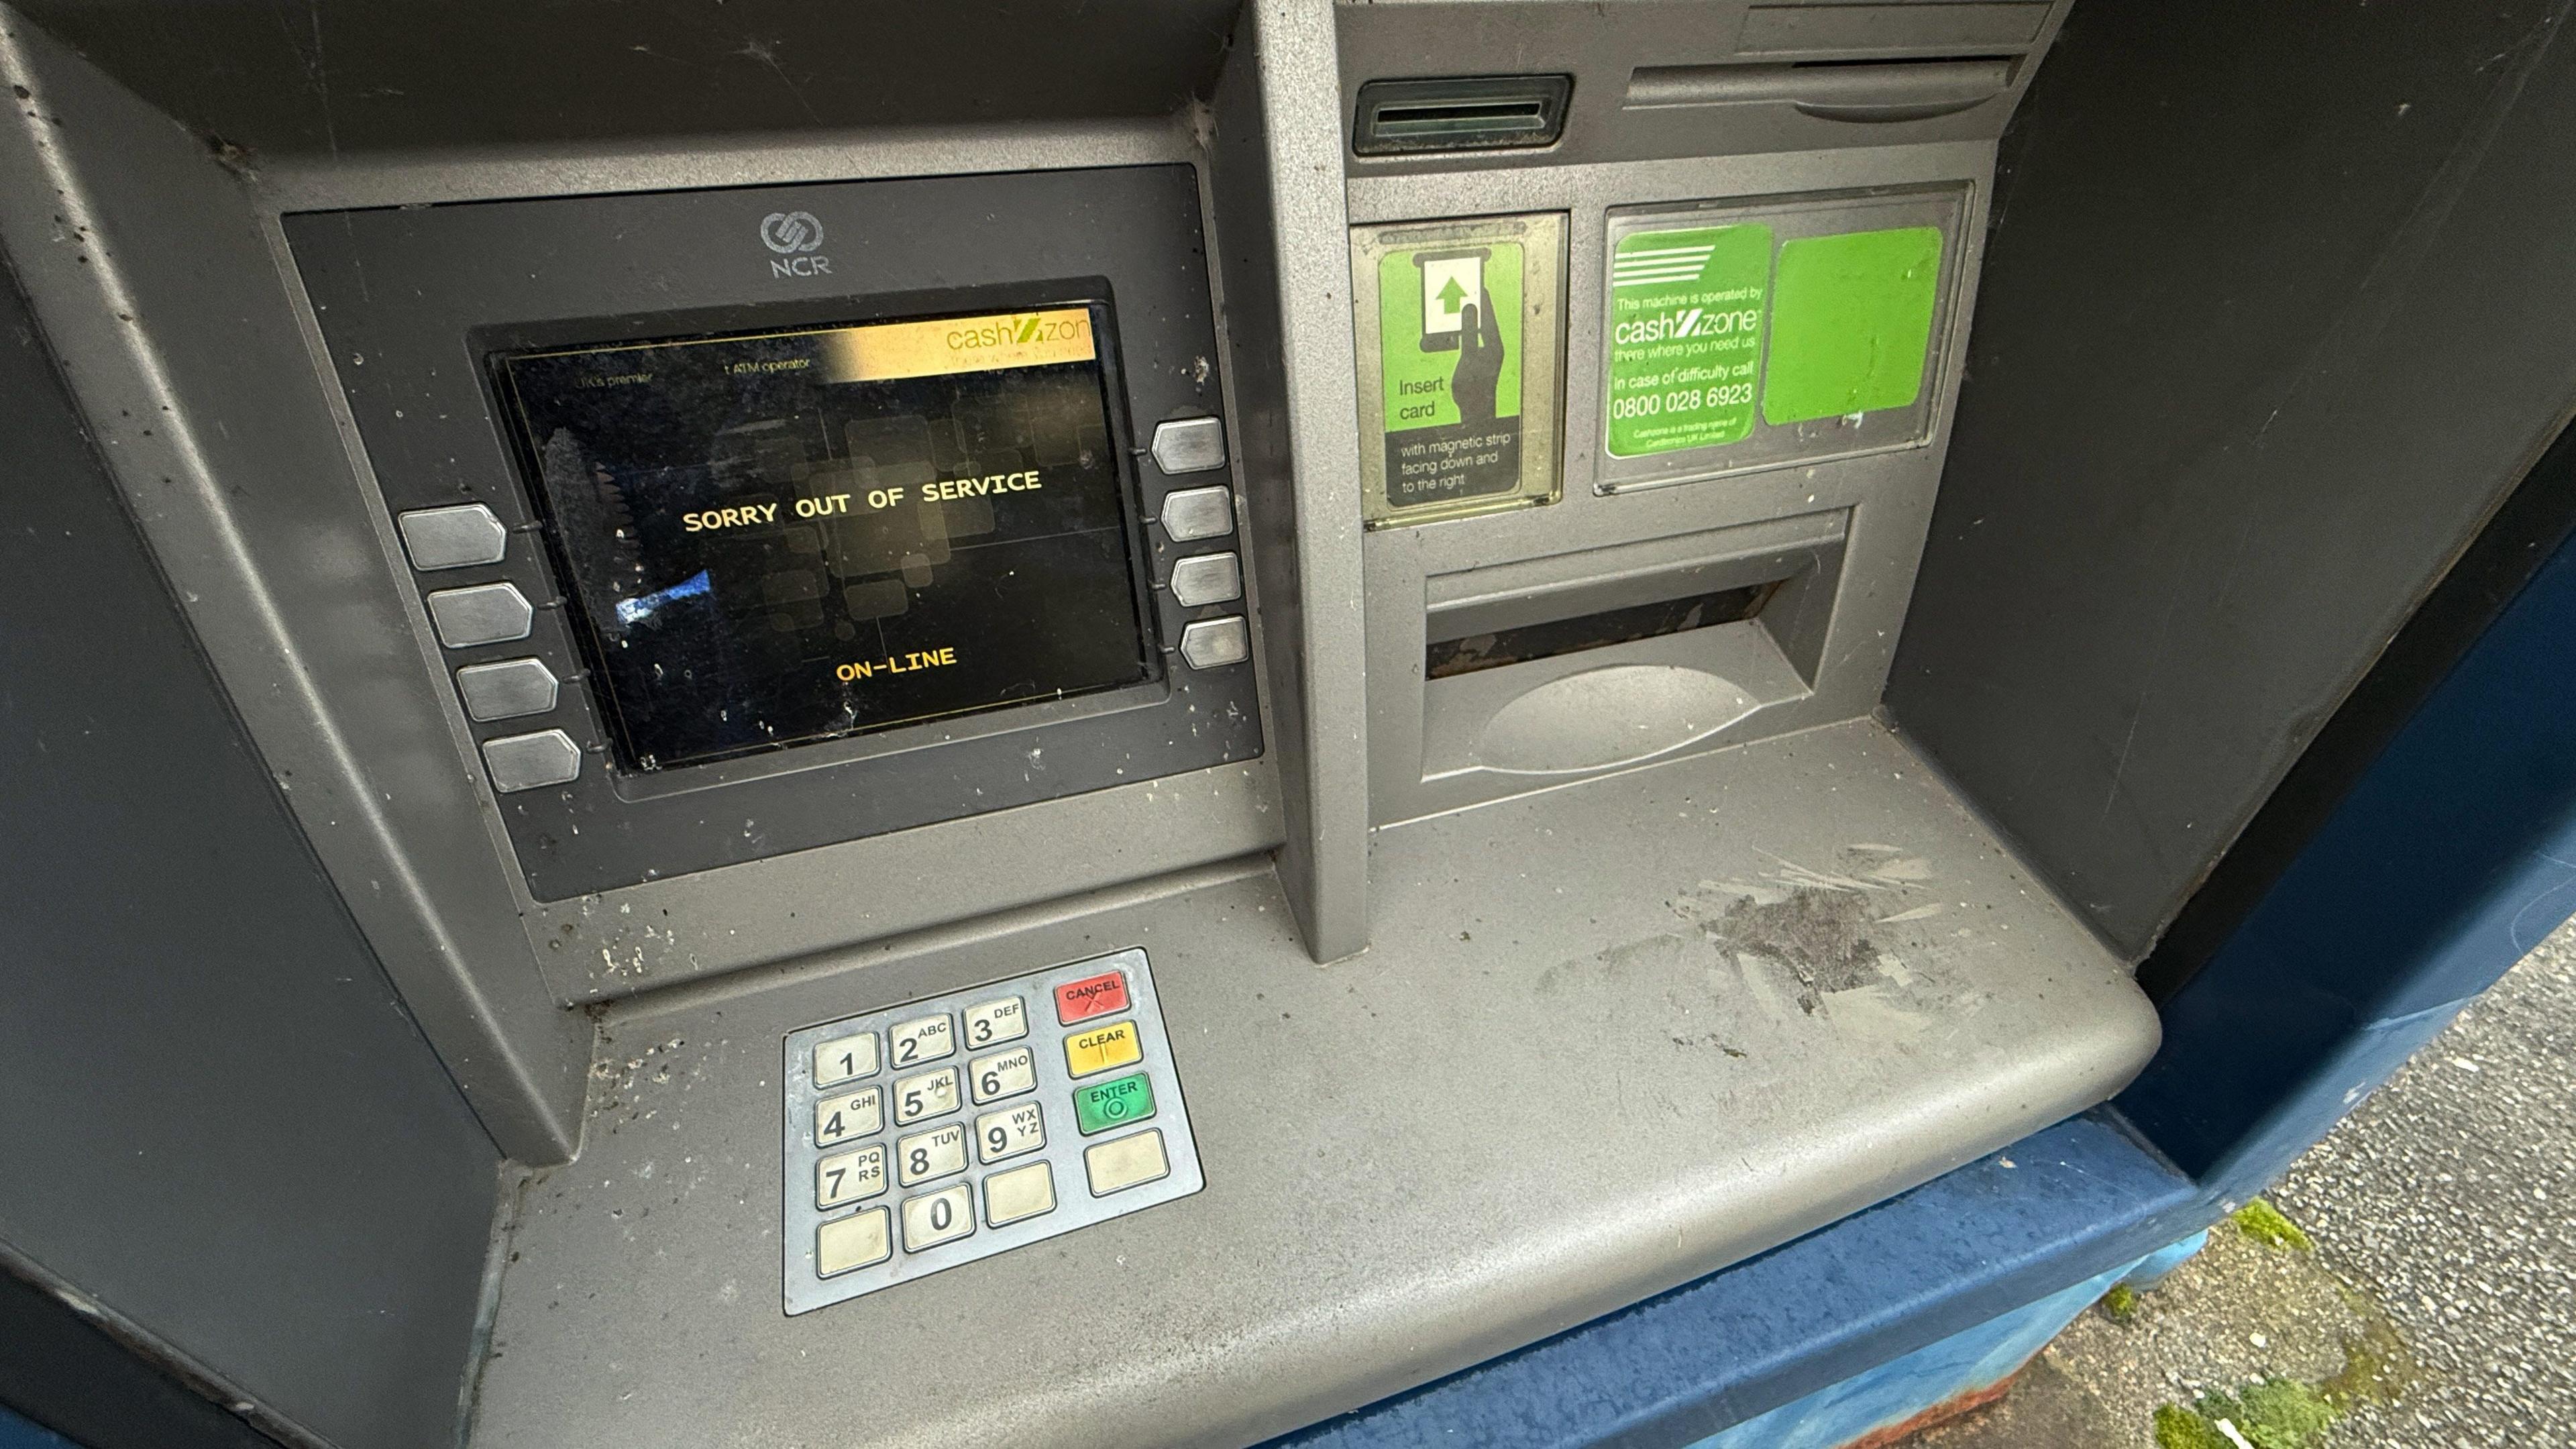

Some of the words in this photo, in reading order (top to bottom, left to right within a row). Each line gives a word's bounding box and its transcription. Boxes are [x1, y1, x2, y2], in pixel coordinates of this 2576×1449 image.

[770, 256, 833, 279] NCR
[1617, 298, 1640, 311] This
[1642, 294, 1687, 309] machine
[1690, 292, 1699, 304] is
[1701, 287, 1747, 306] operated
[1750, 286, 1763, 301] by
[1615, 347, 1645, 362] there
[1648, 343, 1684, 358] where
[1685, 342, 1707, 358] you
[1709, 335, 1739, 351] need
[1741, 337, 1756, 348] us
[734, 362, 759, 374] ATM
[762, 359, 810, 374] operator
[1628, 374, 1660, 389] case
[1662, 367, 1678, 385] of
[1678, 365, 1729, 382] difficulty
[1732, 361, 1754, 376] call
[1399, 376, 1444, 396] Insert
[1399, 401, 1436, 420] card
[1613, 394, 1660, 419] 0800
[1666, 389, 1701, 413] 028
[1707, 382, 1753, 408] 6923
[1401, 443, 1426, 458] with
[1429, 435, 1483, 454] magnetic
[1486, 433, 1511, 447] strip
[1401, 462, 1437, 475] facing
[1440, 456, 1473, 470] down
[1476, 451, 1499, 466] and
[1402, 482, 1414, 494] to
[1417, 479, 1436, 491] the
[1439, 474, 1465, 490] right
[683, 502, 777, 532] SORRY
[795, 494, 851, 519] OUT
[867, 487, 905, 510] OF
[922, 470, 1042, 502] SERVICE
[836, 647, 957, 682] ON-LINE
[1065, 979, 1120, 1001] CANCEL
[974, 1018, 993, 1042] 3
[994, 1004, 1020, 1019] DEF
[899, 1037, 919, 1063] 2
[918, 1022, 947, 1038] ABC
[1079, 1029, 1126, 1049] CLEAR
[840, 1052, 853, 1076] 1
[981, 1071, 1001, 1096] 6
[997, 1055, 1028, 1072] MNO
[904, 1090, 923, 1117] 5
[927, 1075, 954, 1091] JKL
[1091, 1081, 1138, 1103] ENTER
[823, 1111, 845, 1138] 4
[850, 1095, 876, 1111] GHI
[910, 1147, 930, 1175] 8
[931, 1130, 960, 1147] TUV
[987, 1126, 1008, 1154] 9
[826, 1167, 847, 1199] 7
[930, 1197, 953, 1232] 0
